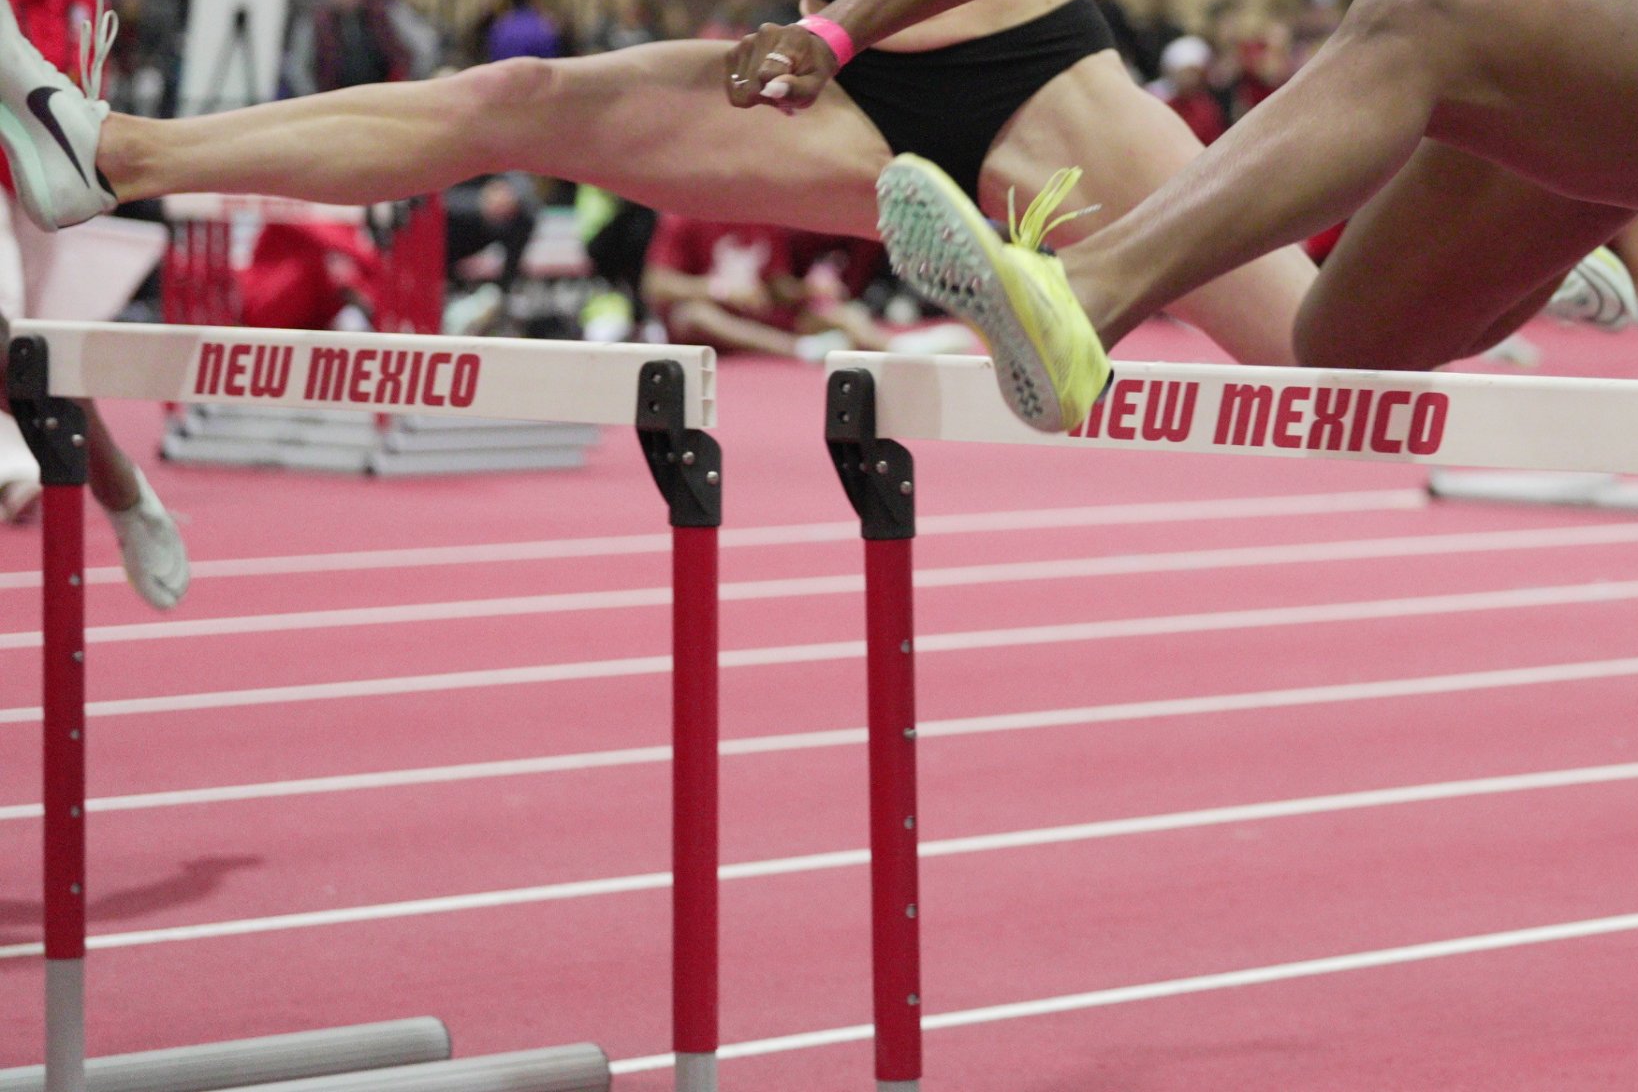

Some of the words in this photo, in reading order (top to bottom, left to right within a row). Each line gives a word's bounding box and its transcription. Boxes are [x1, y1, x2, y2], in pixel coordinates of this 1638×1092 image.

[194, 342, 294, 398] NEW
[304, 347, 481, 408] MEXICO
[1213, 383, 1450, 455] MEXICO
